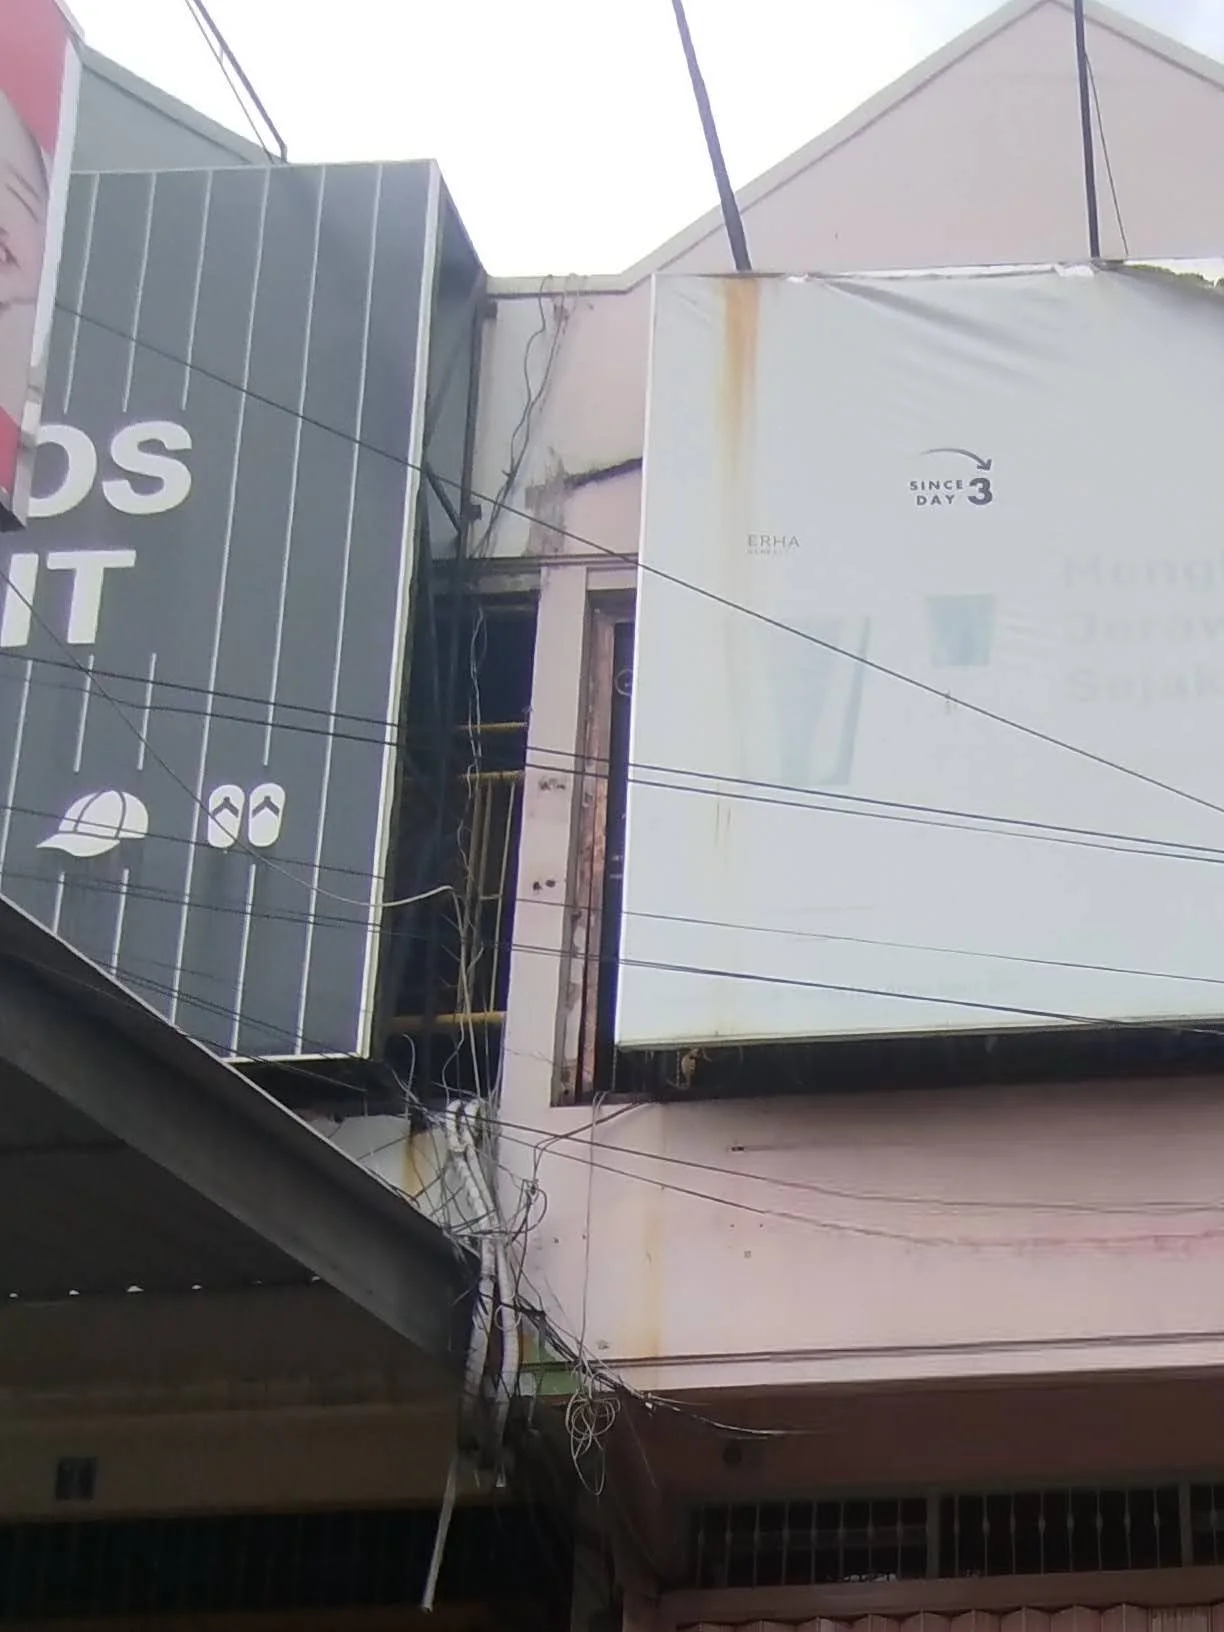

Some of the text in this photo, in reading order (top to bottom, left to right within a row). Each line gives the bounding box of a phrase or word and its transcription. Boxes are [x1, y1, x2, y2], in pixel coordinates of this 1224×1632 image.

[910, 479, 964, 491] SINCE
[916, 477, 993, 506] DAY 3
[747, 534, 800, 548] ERHA
